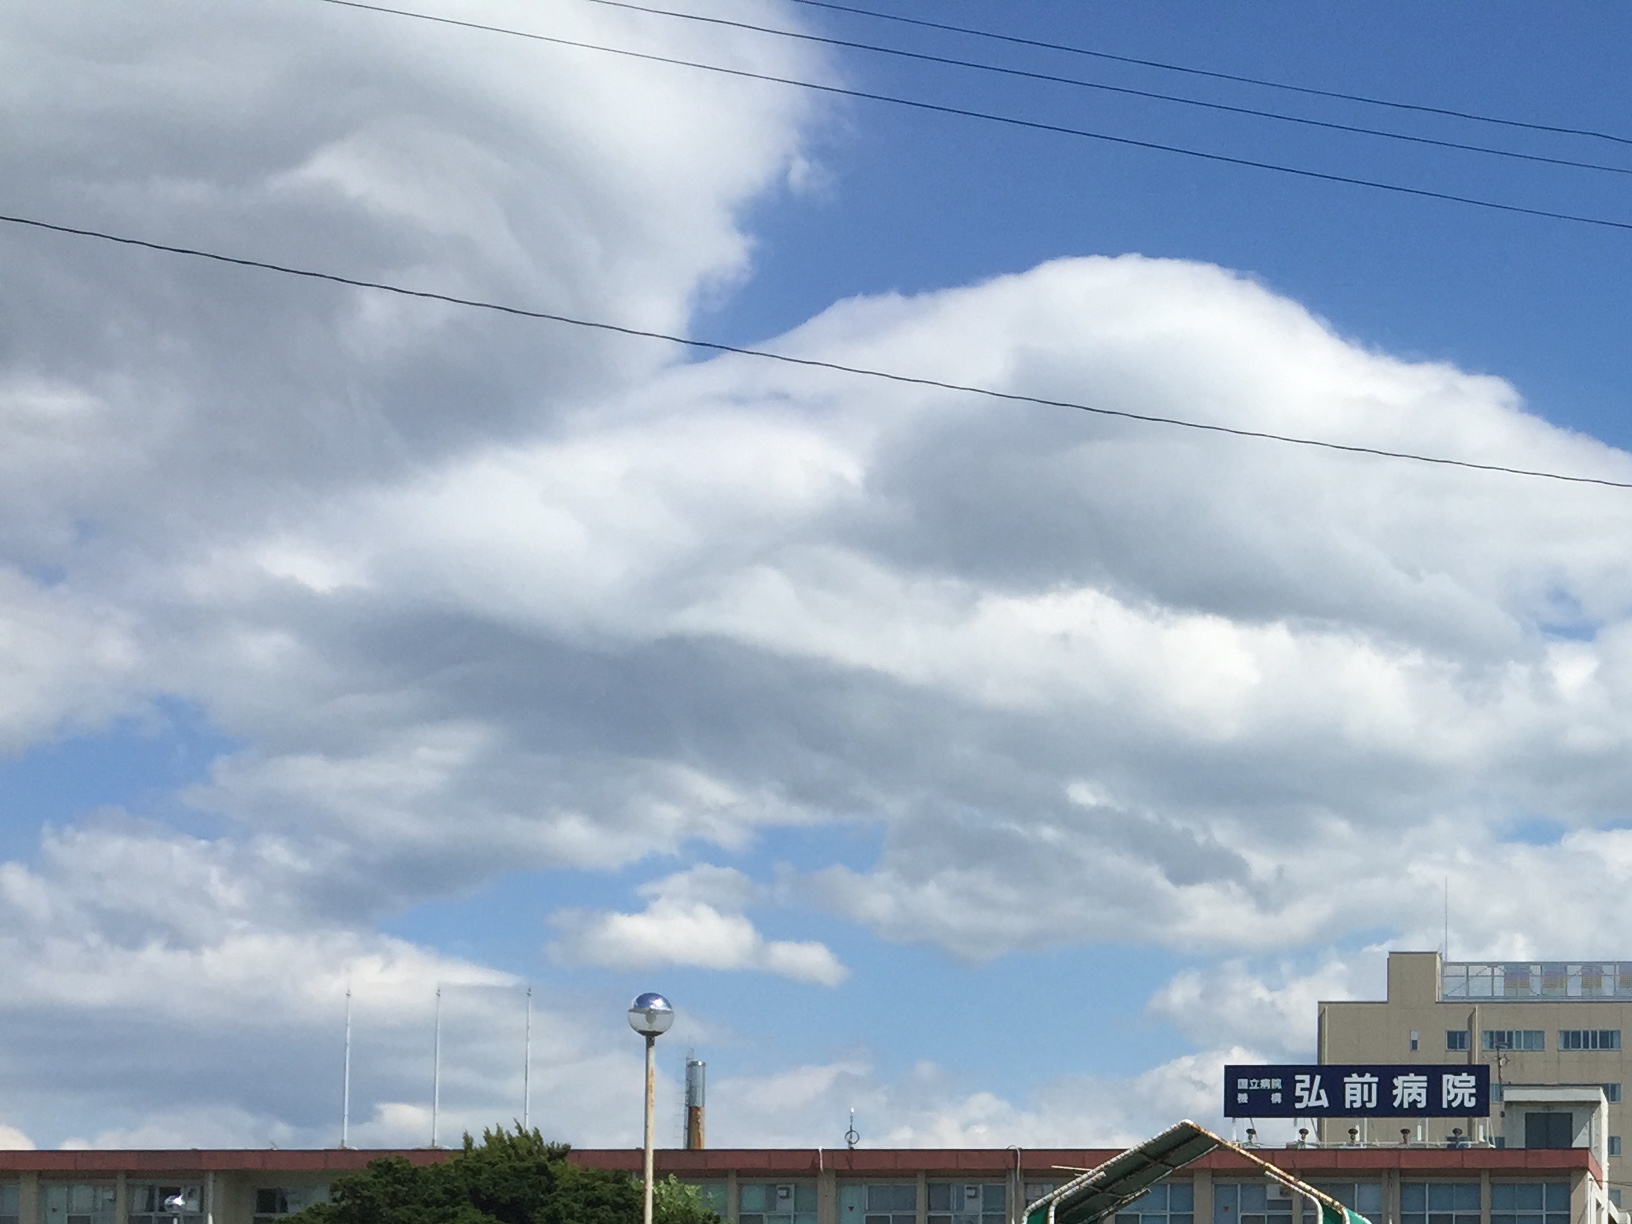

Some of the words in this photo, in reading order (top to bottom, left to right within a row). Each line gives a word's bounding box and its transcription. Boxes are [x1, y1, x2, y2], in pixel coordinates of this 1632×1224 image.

[1237, 1078, 1283, 1090] 国立病院
[1294, 1073, 1476, 1109] 弘前病院
